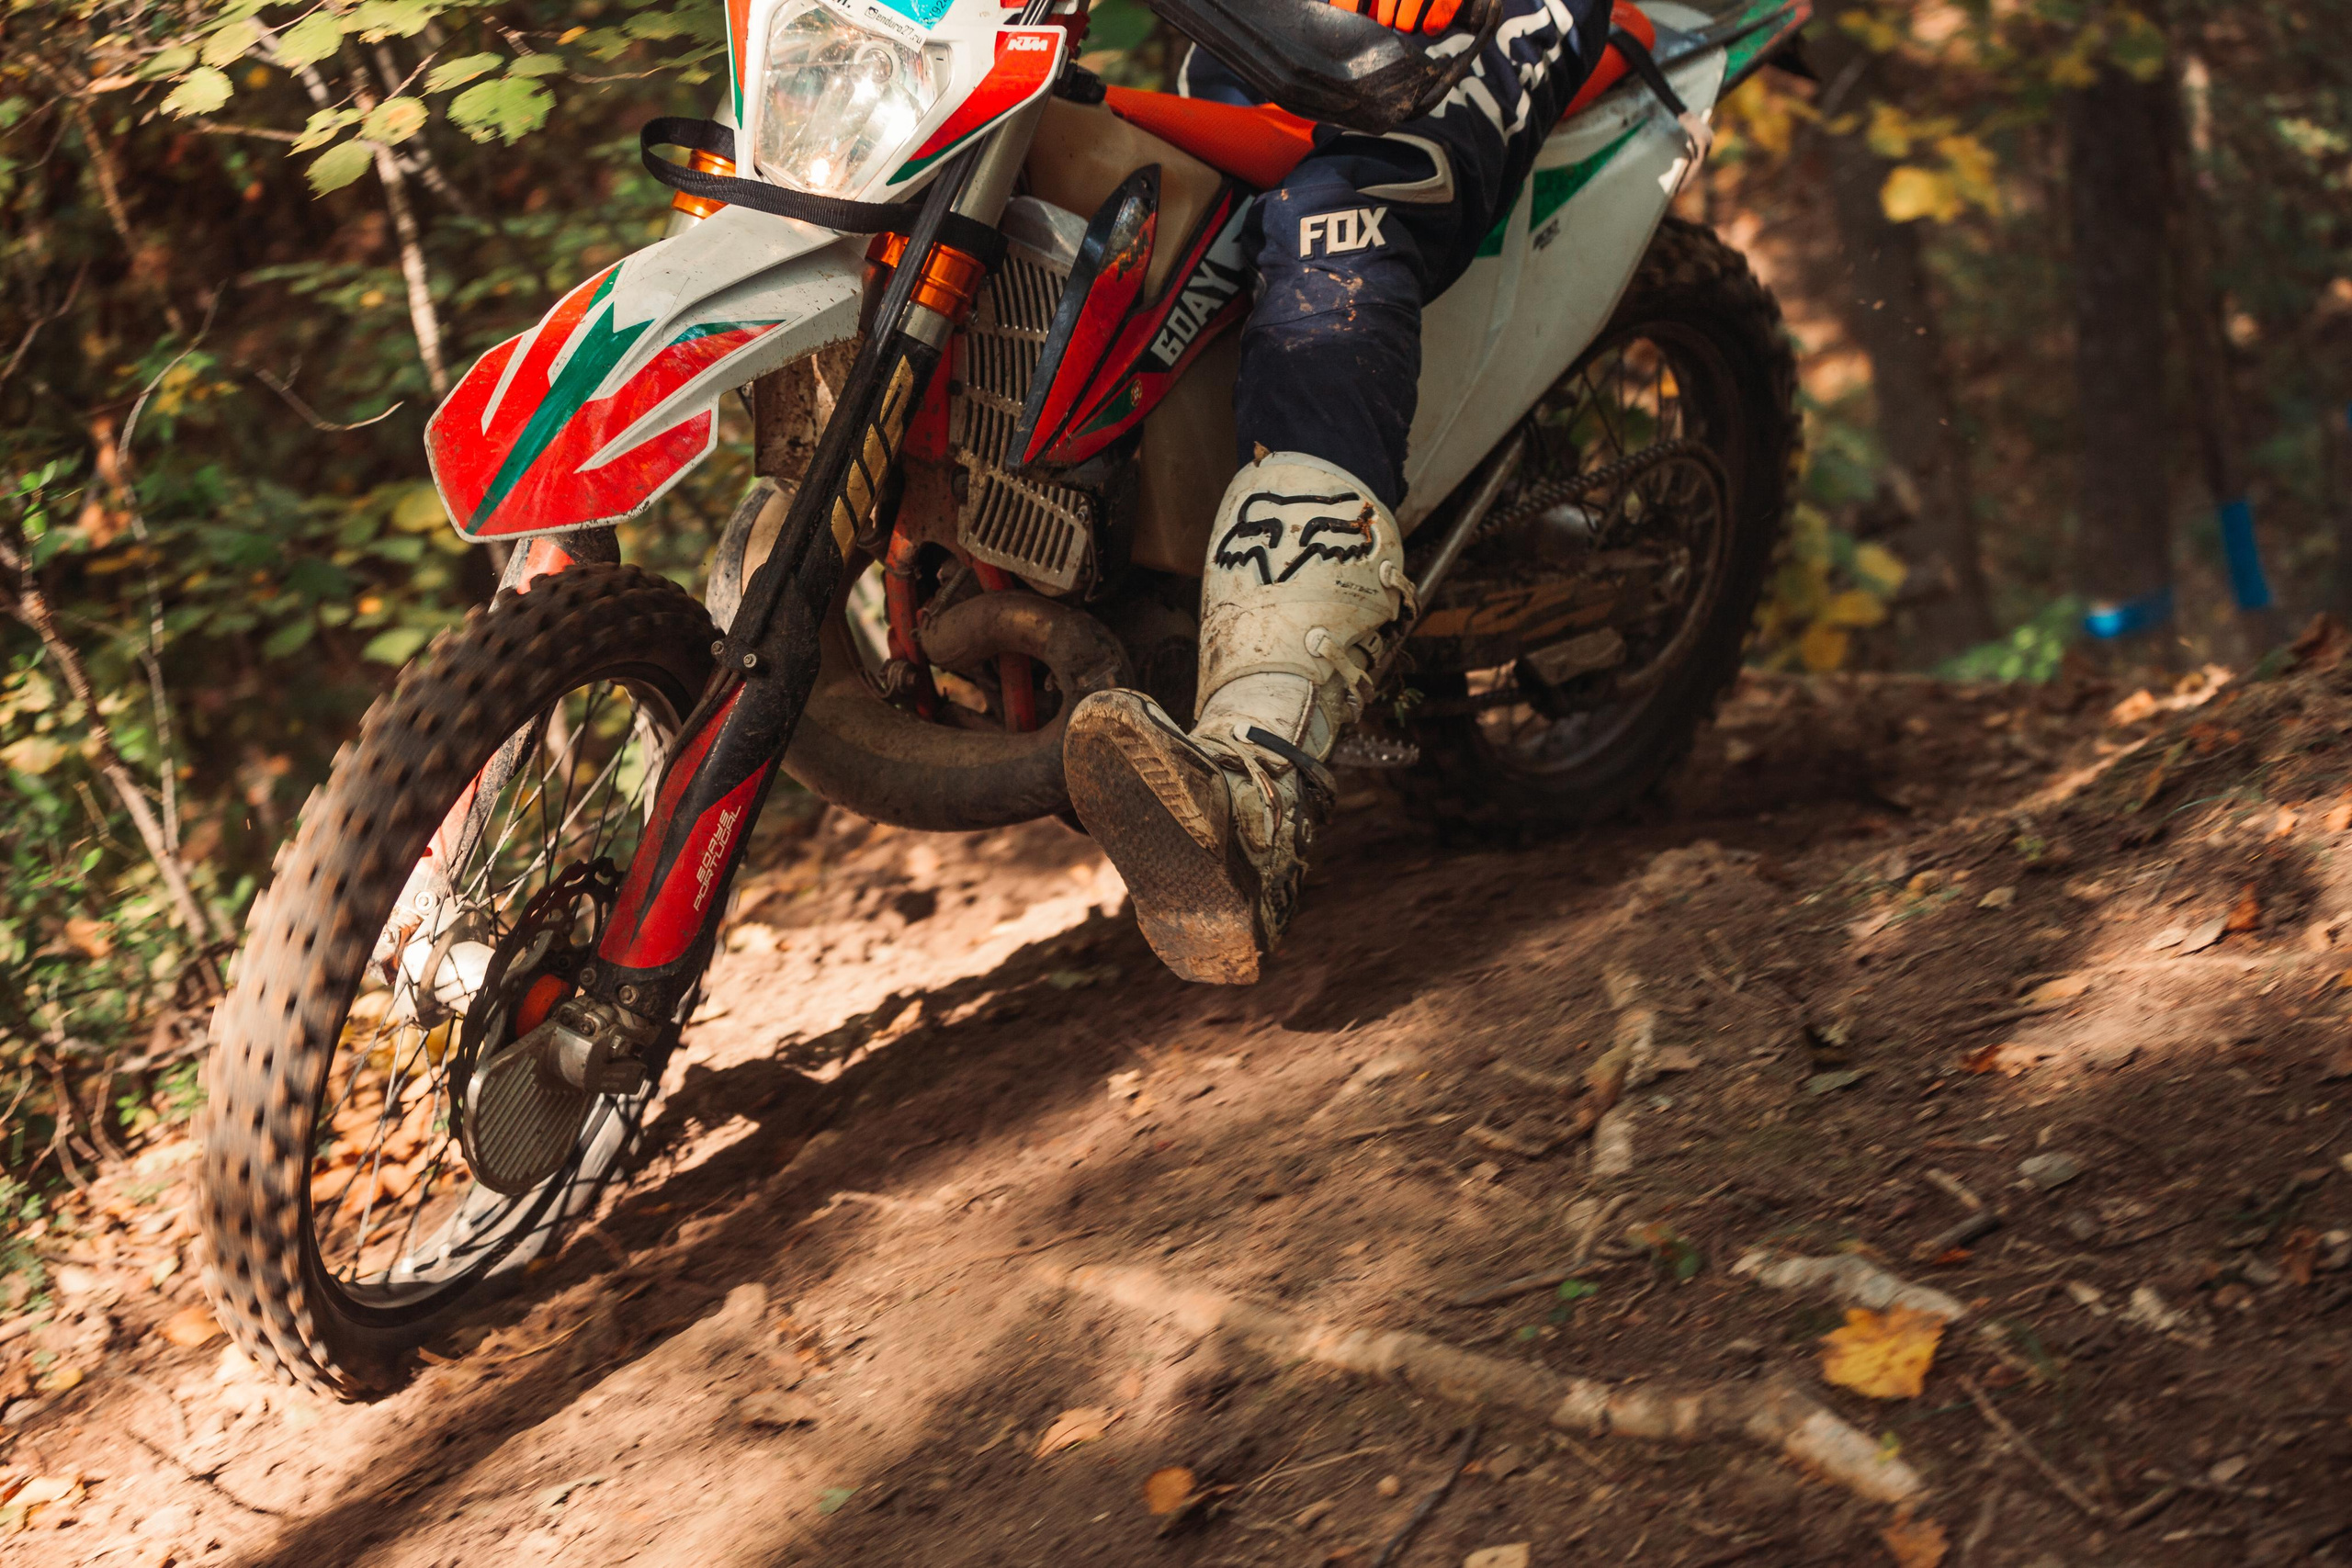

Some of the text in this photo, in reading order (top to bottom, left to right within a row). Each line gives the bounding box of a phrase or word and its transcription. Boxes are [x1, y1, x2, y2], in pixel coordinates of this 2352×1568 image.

[1007, 36, 1048, 51] KTM
[1300, 207, 1387, 258] FOX
[693, 806, 741, 911] PORTUGAL
